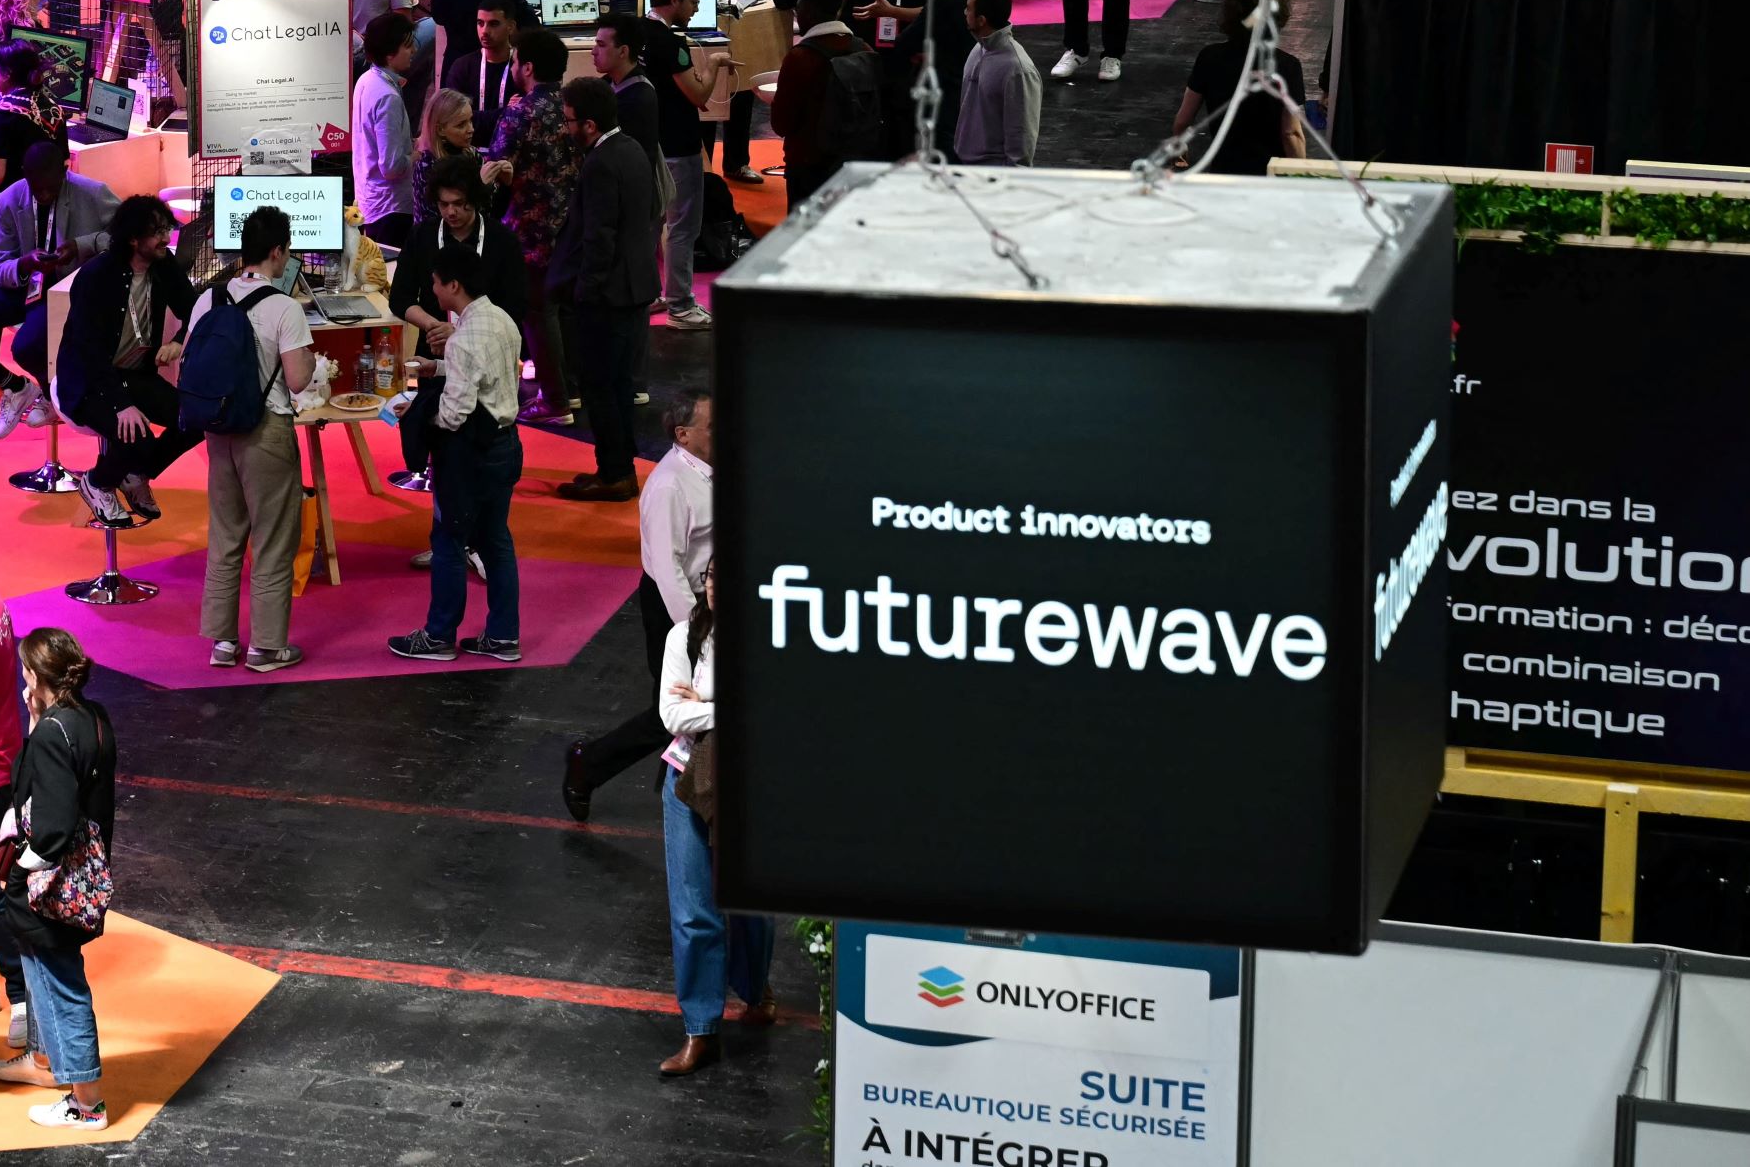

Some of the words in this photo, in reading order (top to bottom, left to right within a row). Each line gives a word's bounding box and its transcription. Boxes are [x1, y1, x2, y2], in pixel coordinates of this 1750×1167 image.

[231, 26, 272, 41] Chat
[275, 22, 342, 42] Legal.IA
[258, 138, 275, 146] Chat
[327, 132, 345, 140] C50
[246, 189, 276, 201] Chat
[871, 496, 1010, 536] Product
[1020, 503, 1212, 546] innovators
[1510, 490, 1611, 520] dans
[1623, 497, 1656, 523] la
[757, 563, 1327, 683] futurewave
[1447, 596, 1633, 634] ormation
[1463, 651, 1720, 692] combinaison
[1450, 691, 1665, 738] haptique
[975, 980, 1156, 1022] ONLYOFFICE
[862, 1082, 1052, 1123] BUREAUTIQUE
[1059, 1104, 1207, 1140] SÉCURISÉE
[1079, 1070, 1207, 1113] SUITE
[861, 1116, 892, 1155] À
[903, 1130, 1110, 1167] INTÉGRER
